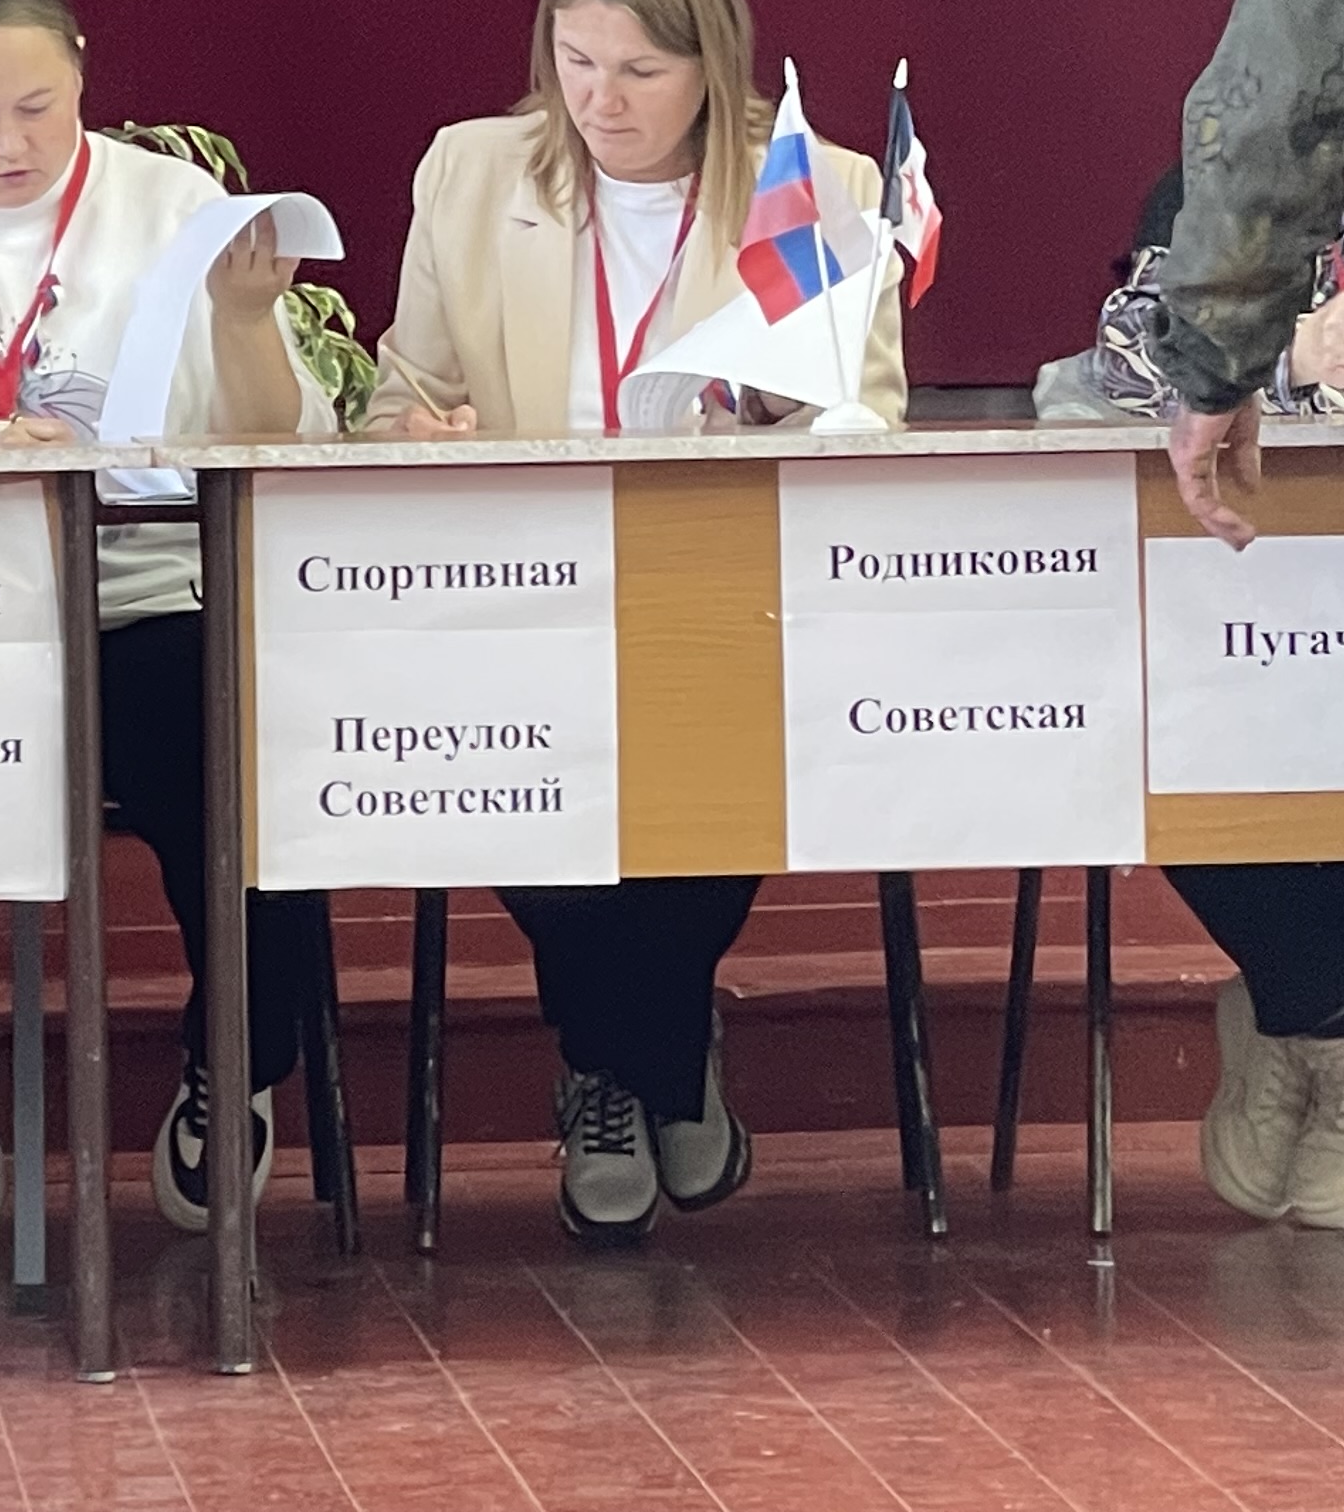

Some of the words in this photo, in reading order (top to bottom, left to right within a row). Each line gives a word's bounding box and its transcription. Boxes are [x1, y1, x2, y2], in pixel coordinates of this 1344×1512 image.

[297, 555, 578, 601] Спортивная
[829, 544, 1098, 581] Родниковая
[848, 697, 1086, 735] Советская
[333, 717, 552, 762] Переулок
[319, 777, 563, 818] Советский
